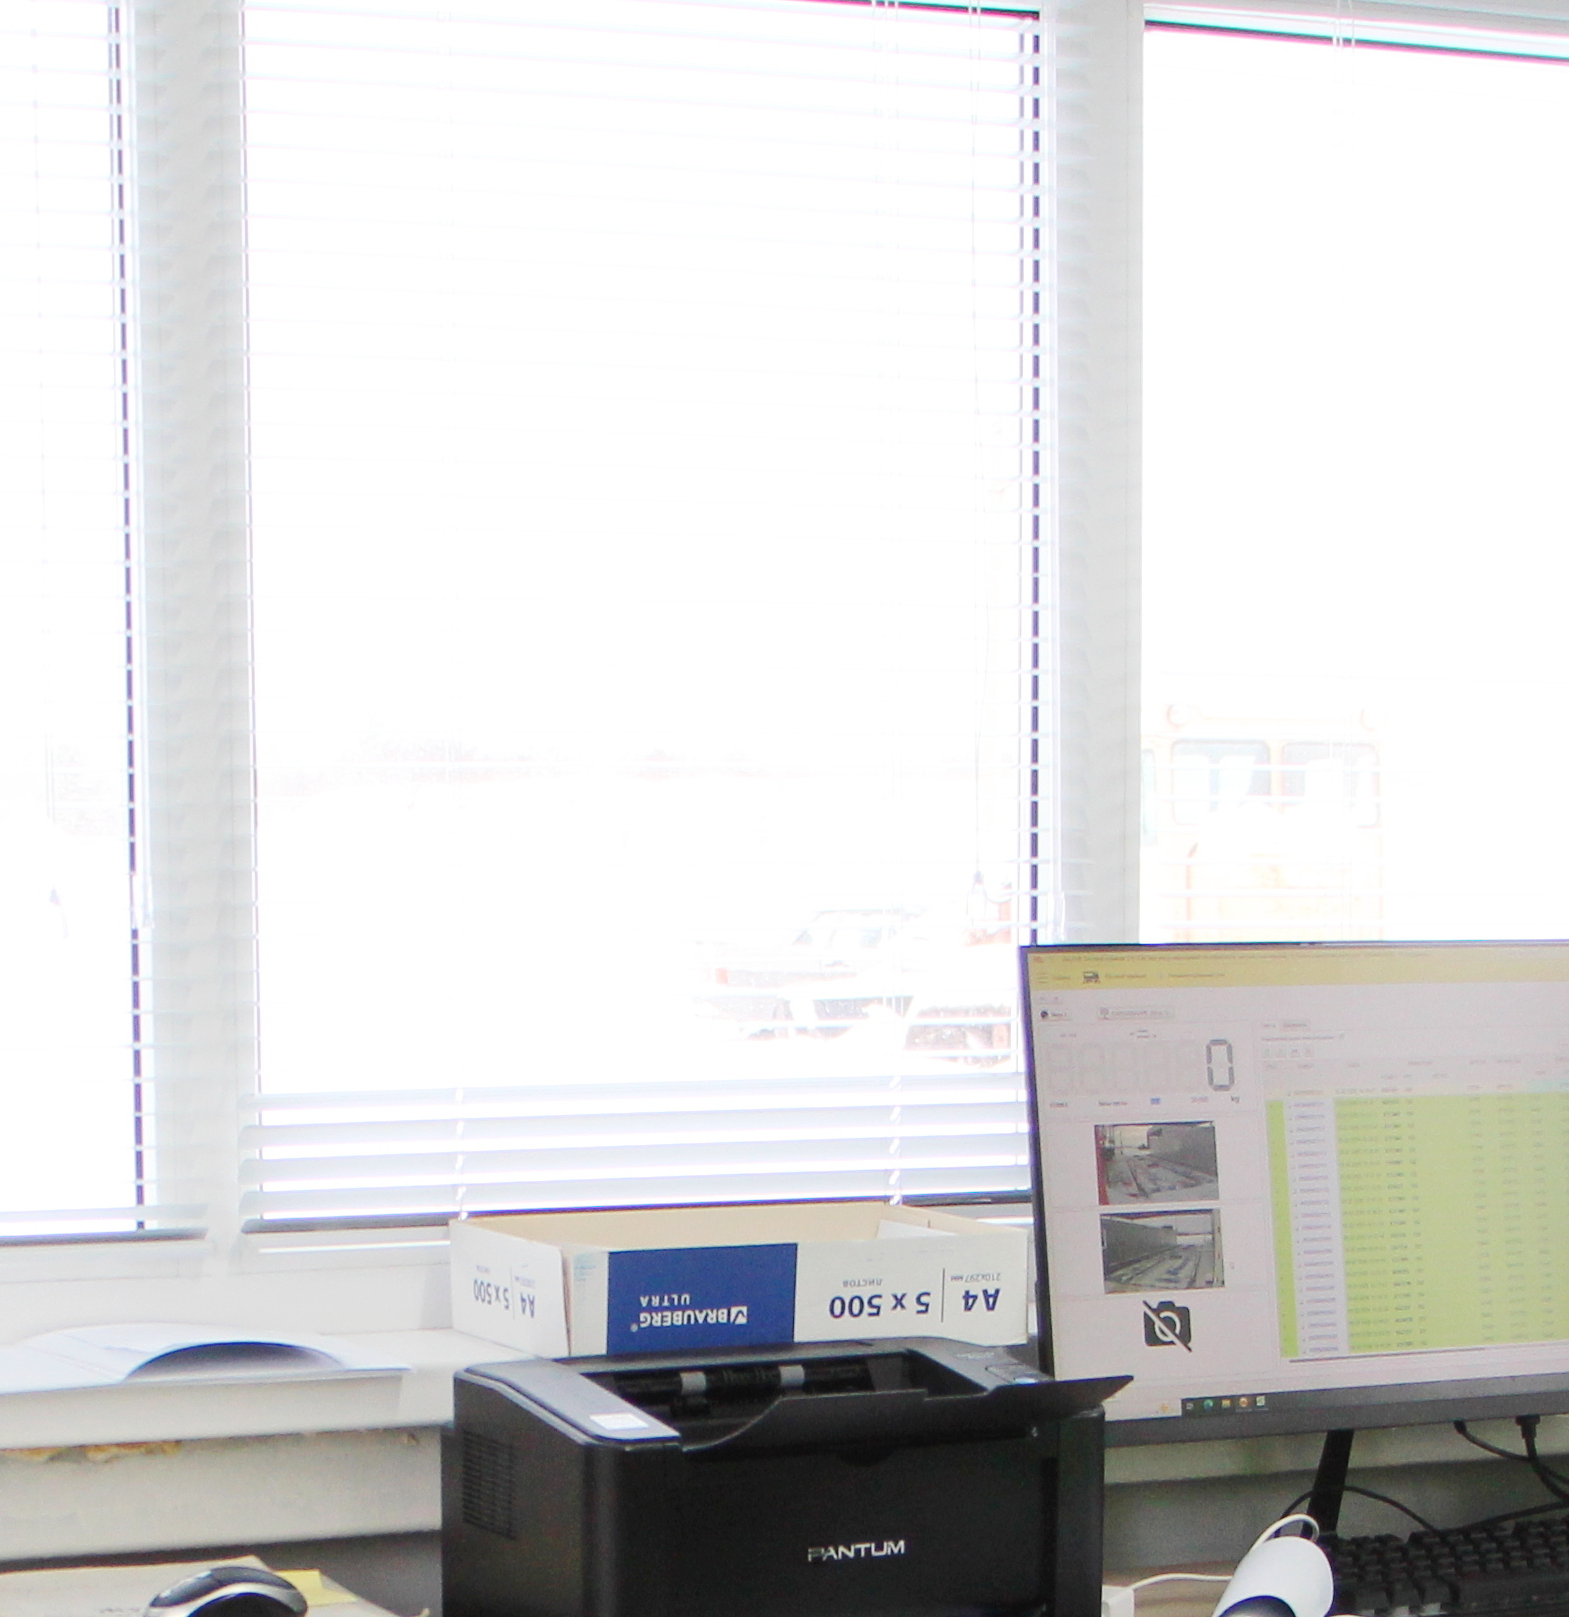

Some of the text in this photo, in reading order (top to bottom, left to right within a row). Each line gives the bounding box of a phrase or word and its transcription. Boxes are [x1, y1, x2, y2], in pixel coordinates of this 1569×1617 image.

[473, 1279, 492, 1306] 500
[639, 1294, 691, 1306] ULTRA
[915, 1292, 932, 1316] 5
[962, 1288, 1001, 1313] A4
[520, 1293, 535, 1318] A4
[829, 1294, 884, 1319] 500
[807, 1540, 906, 1562] PANTUM
